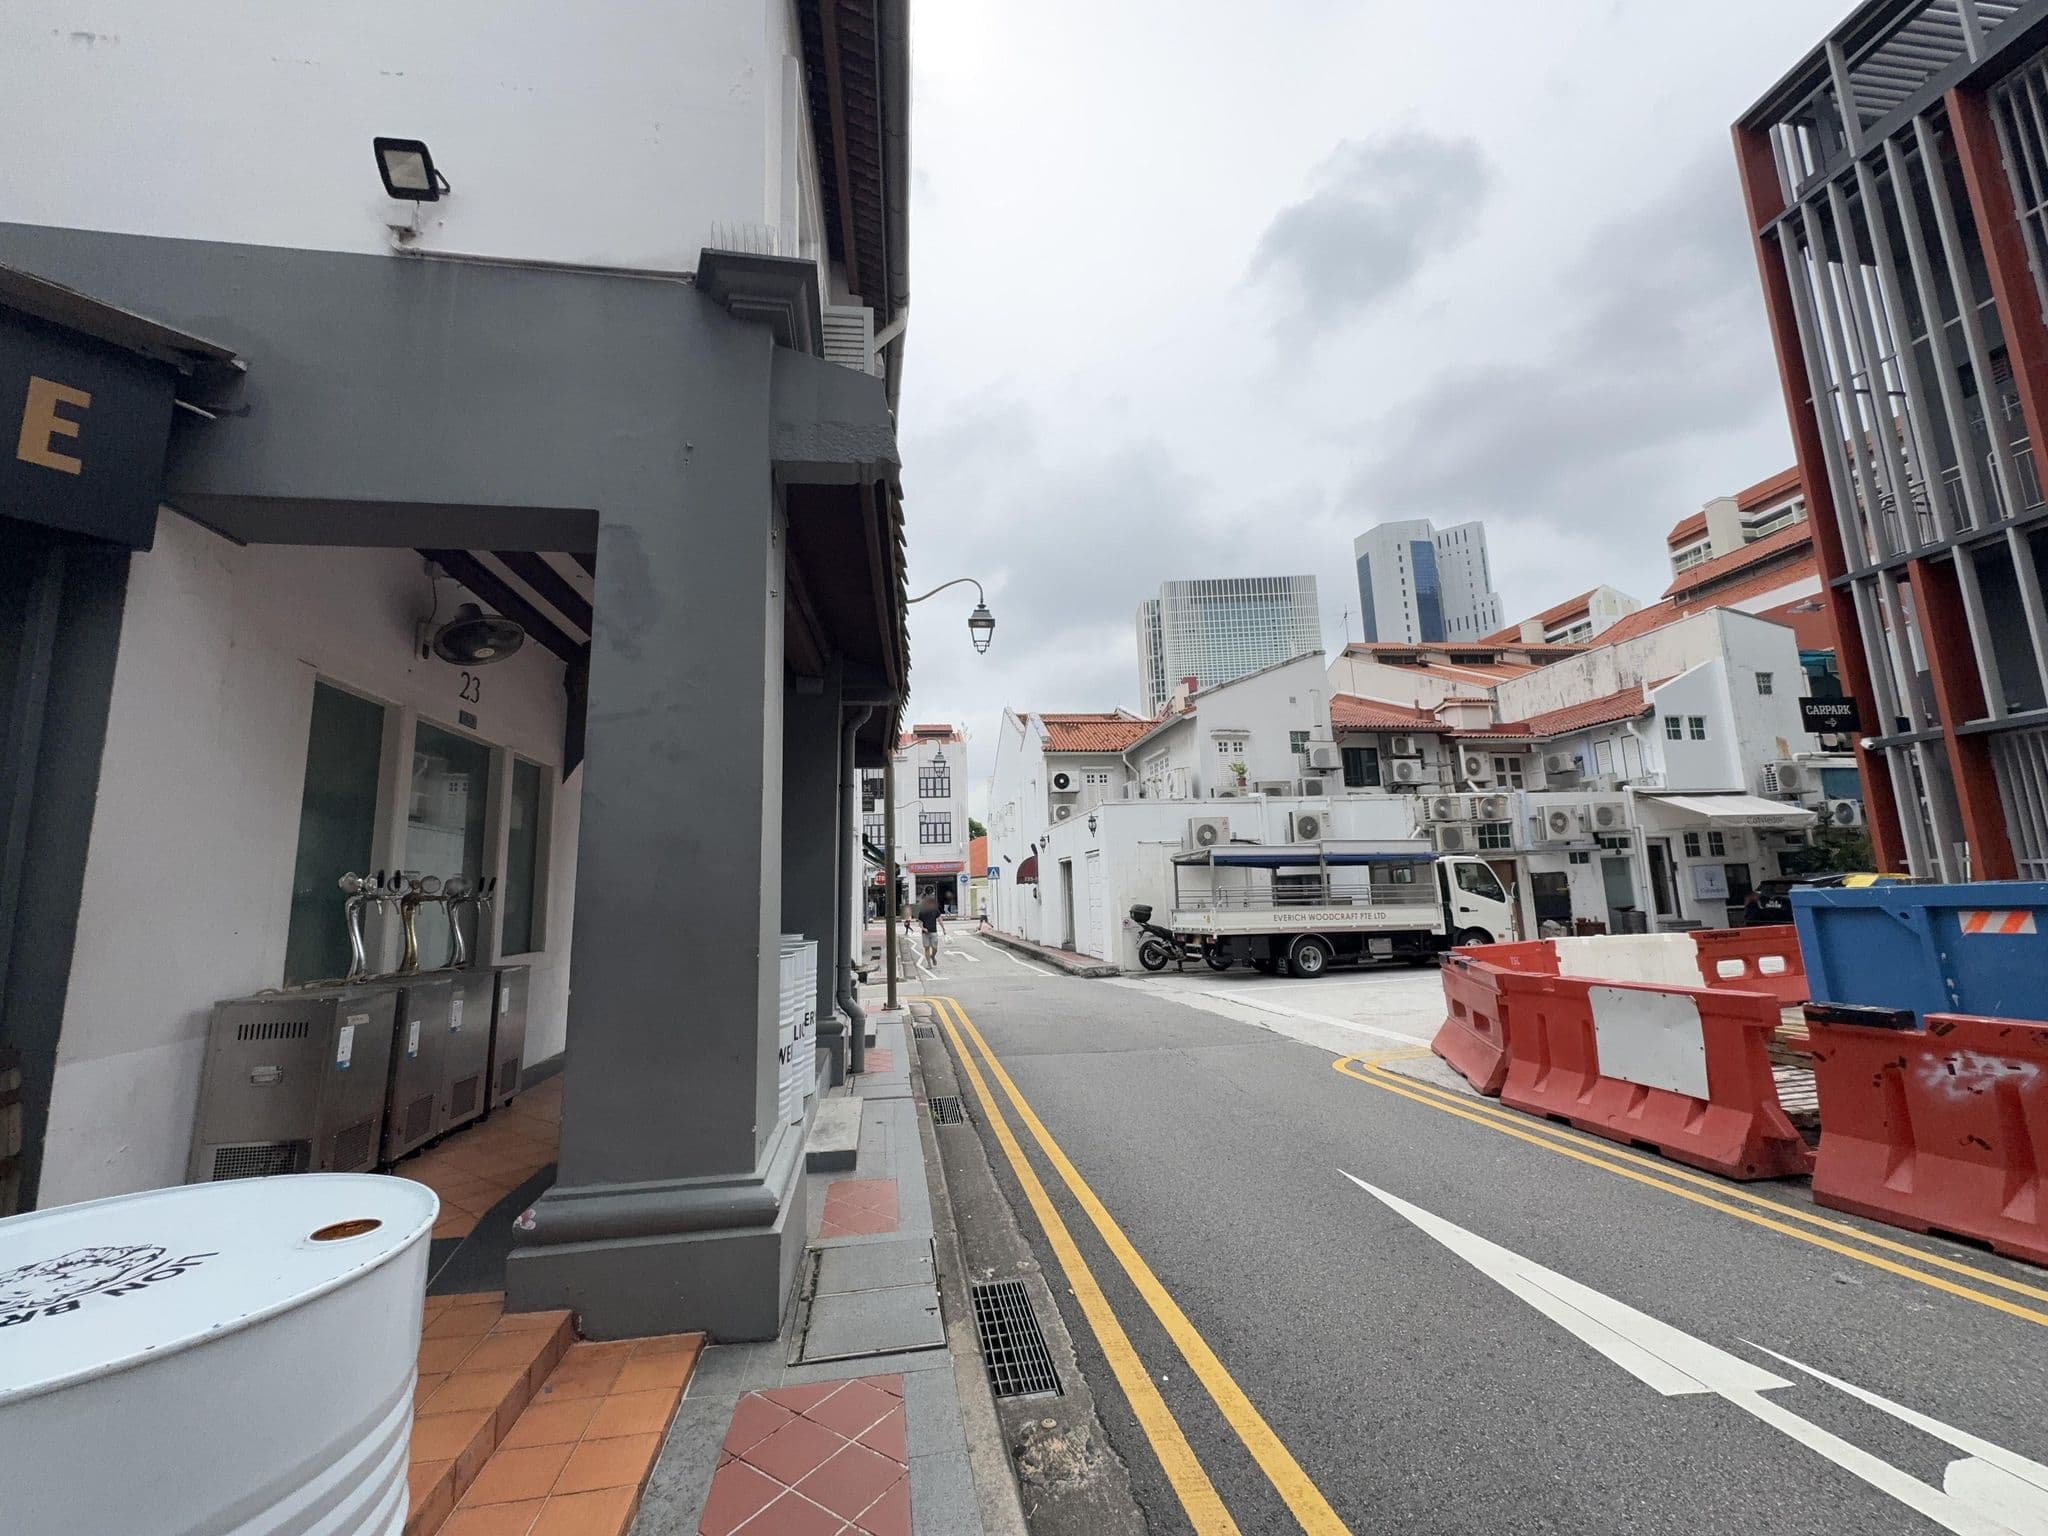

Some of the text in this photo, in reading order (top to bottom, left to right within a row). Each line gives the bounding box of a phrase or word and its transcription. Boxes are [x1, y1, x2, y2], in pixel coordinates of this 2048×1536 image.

[16, 376, 92, 475] E
[459, 671, 481, 703] 23
[1806, 705, 1851, 715] CARPARK
[1273, 912, 1387, 922] EVERICH WOODCRAFT PTE LTD
